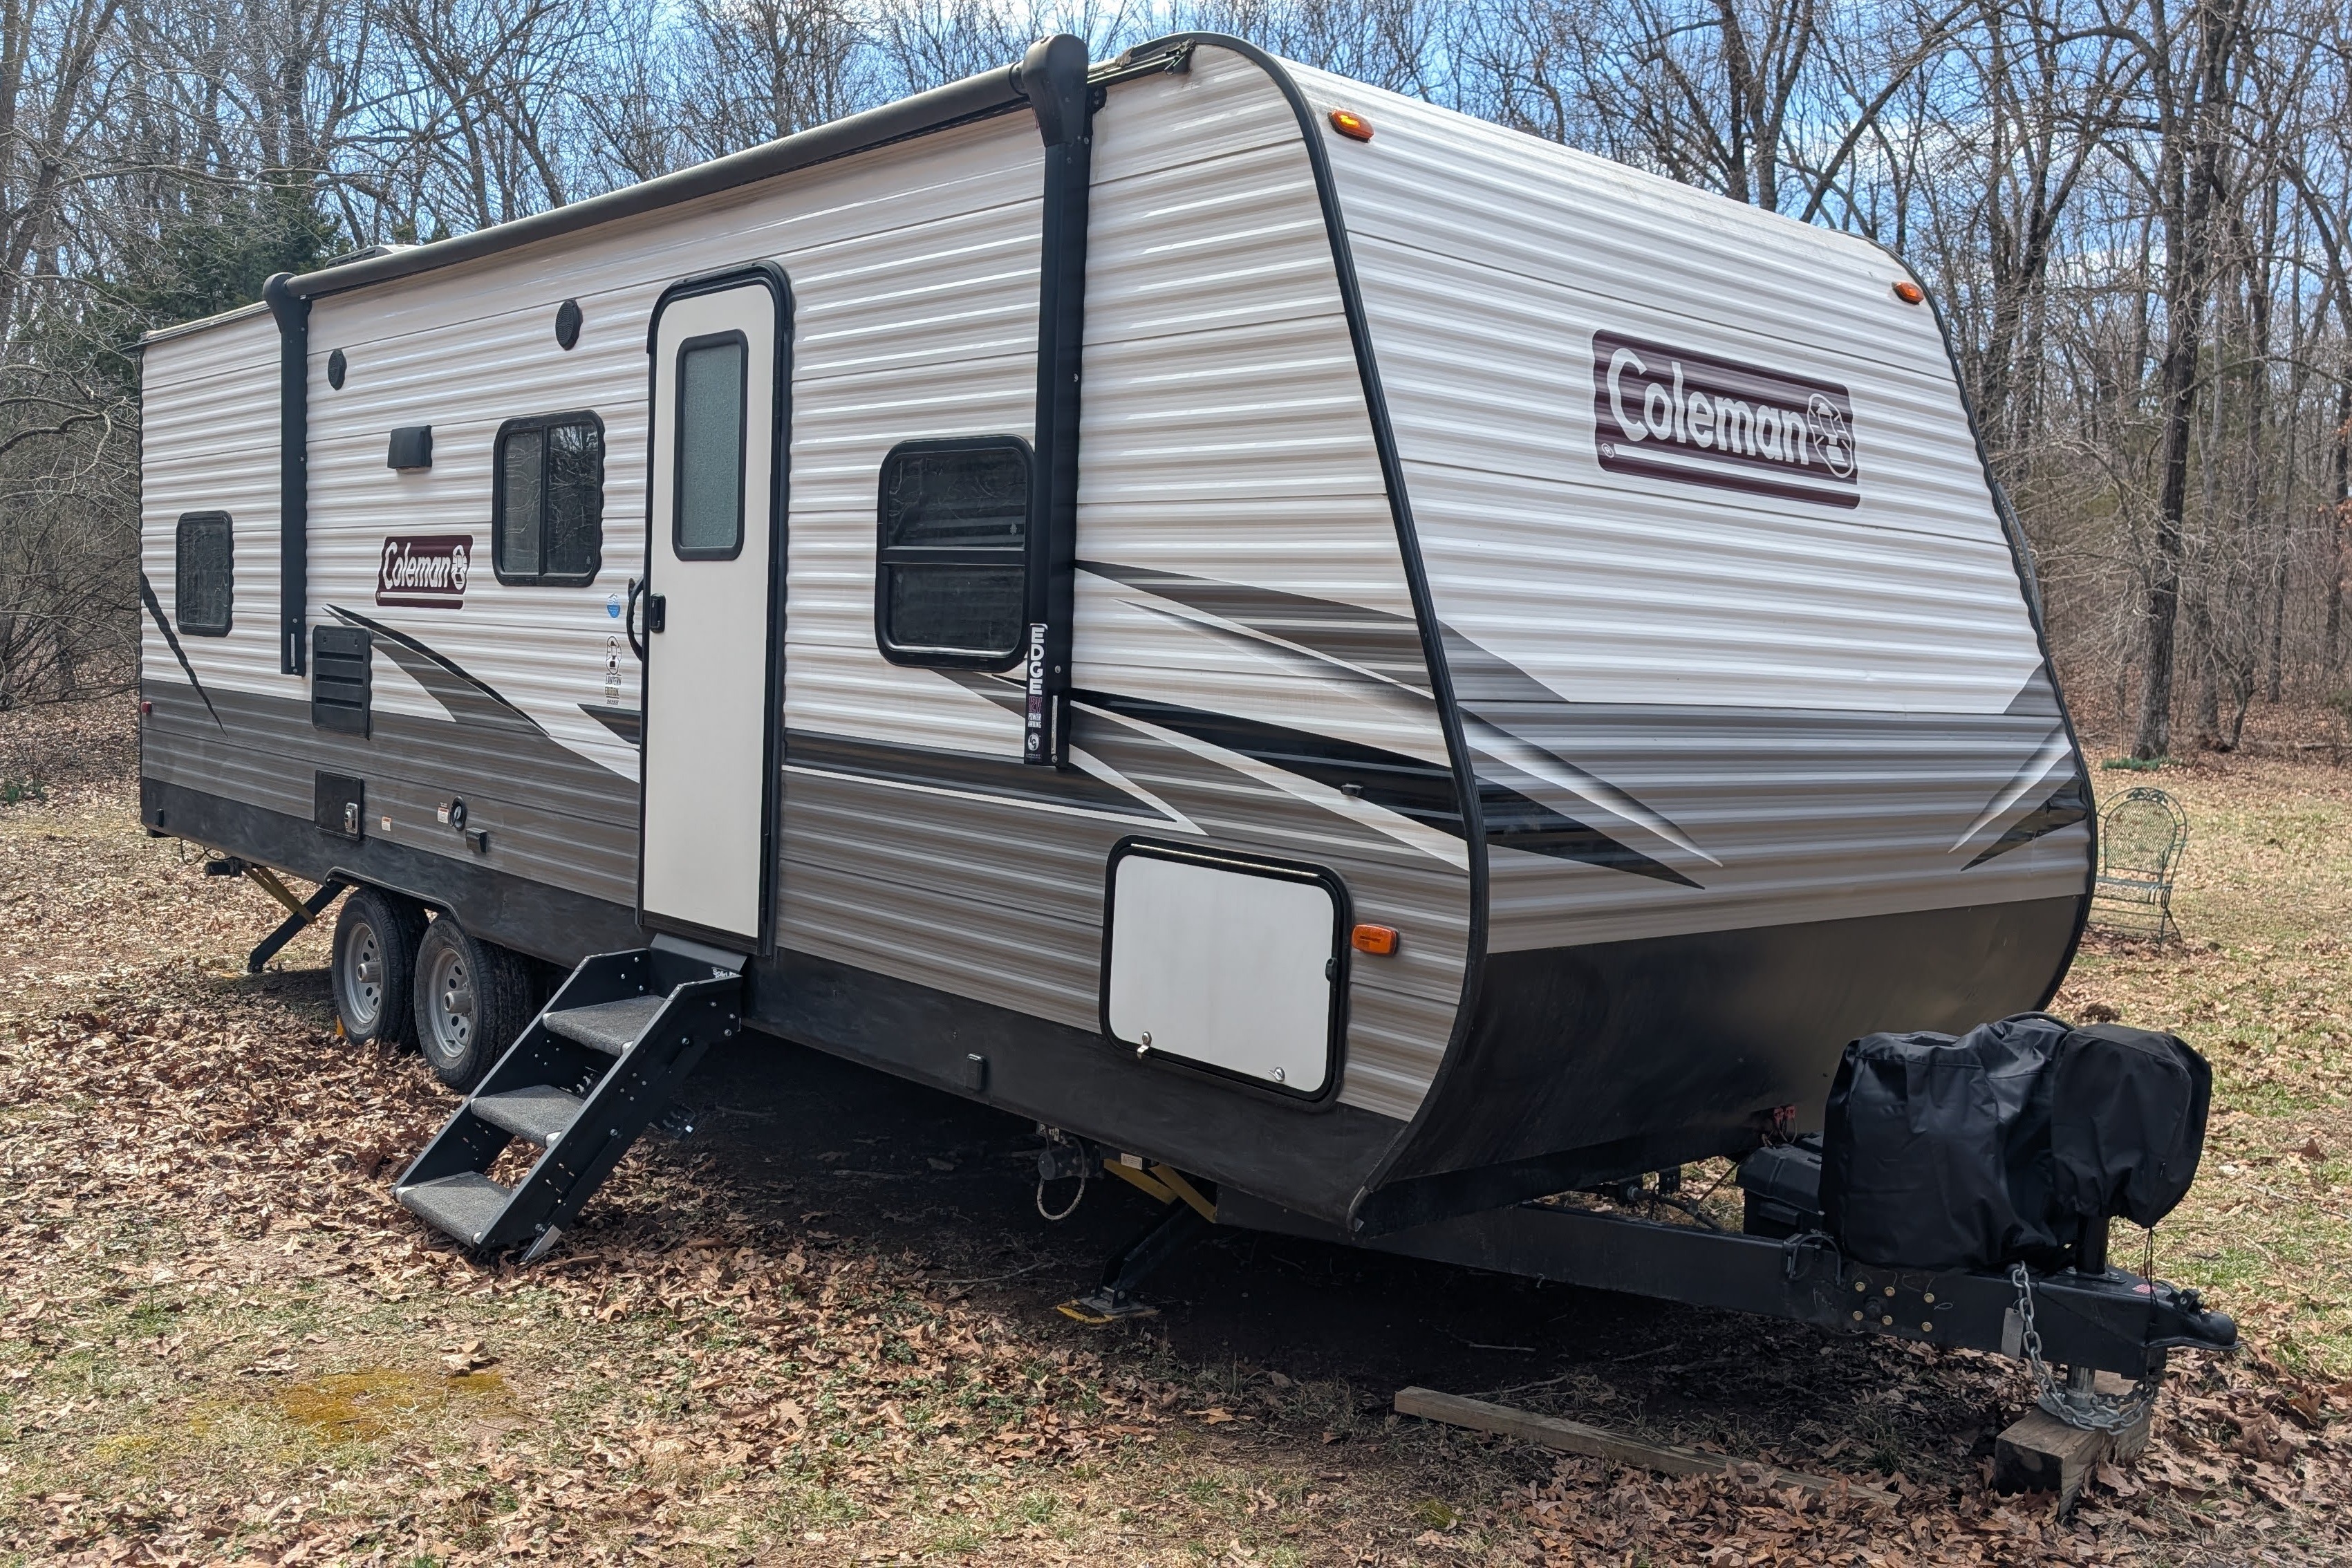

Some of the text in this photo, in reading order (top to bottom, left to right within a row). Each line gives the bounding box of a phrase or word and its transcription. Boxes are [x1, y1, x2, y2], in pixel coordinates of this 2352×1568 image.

[1607, 347, 1809, 465] Coleman
[382, 541, 451, 590] Coleman
[1029, 626, 1045, 696] EDGE
[1028, 712, 1042, 721] POWER
[1029, 696, 1043, 713] 12V
